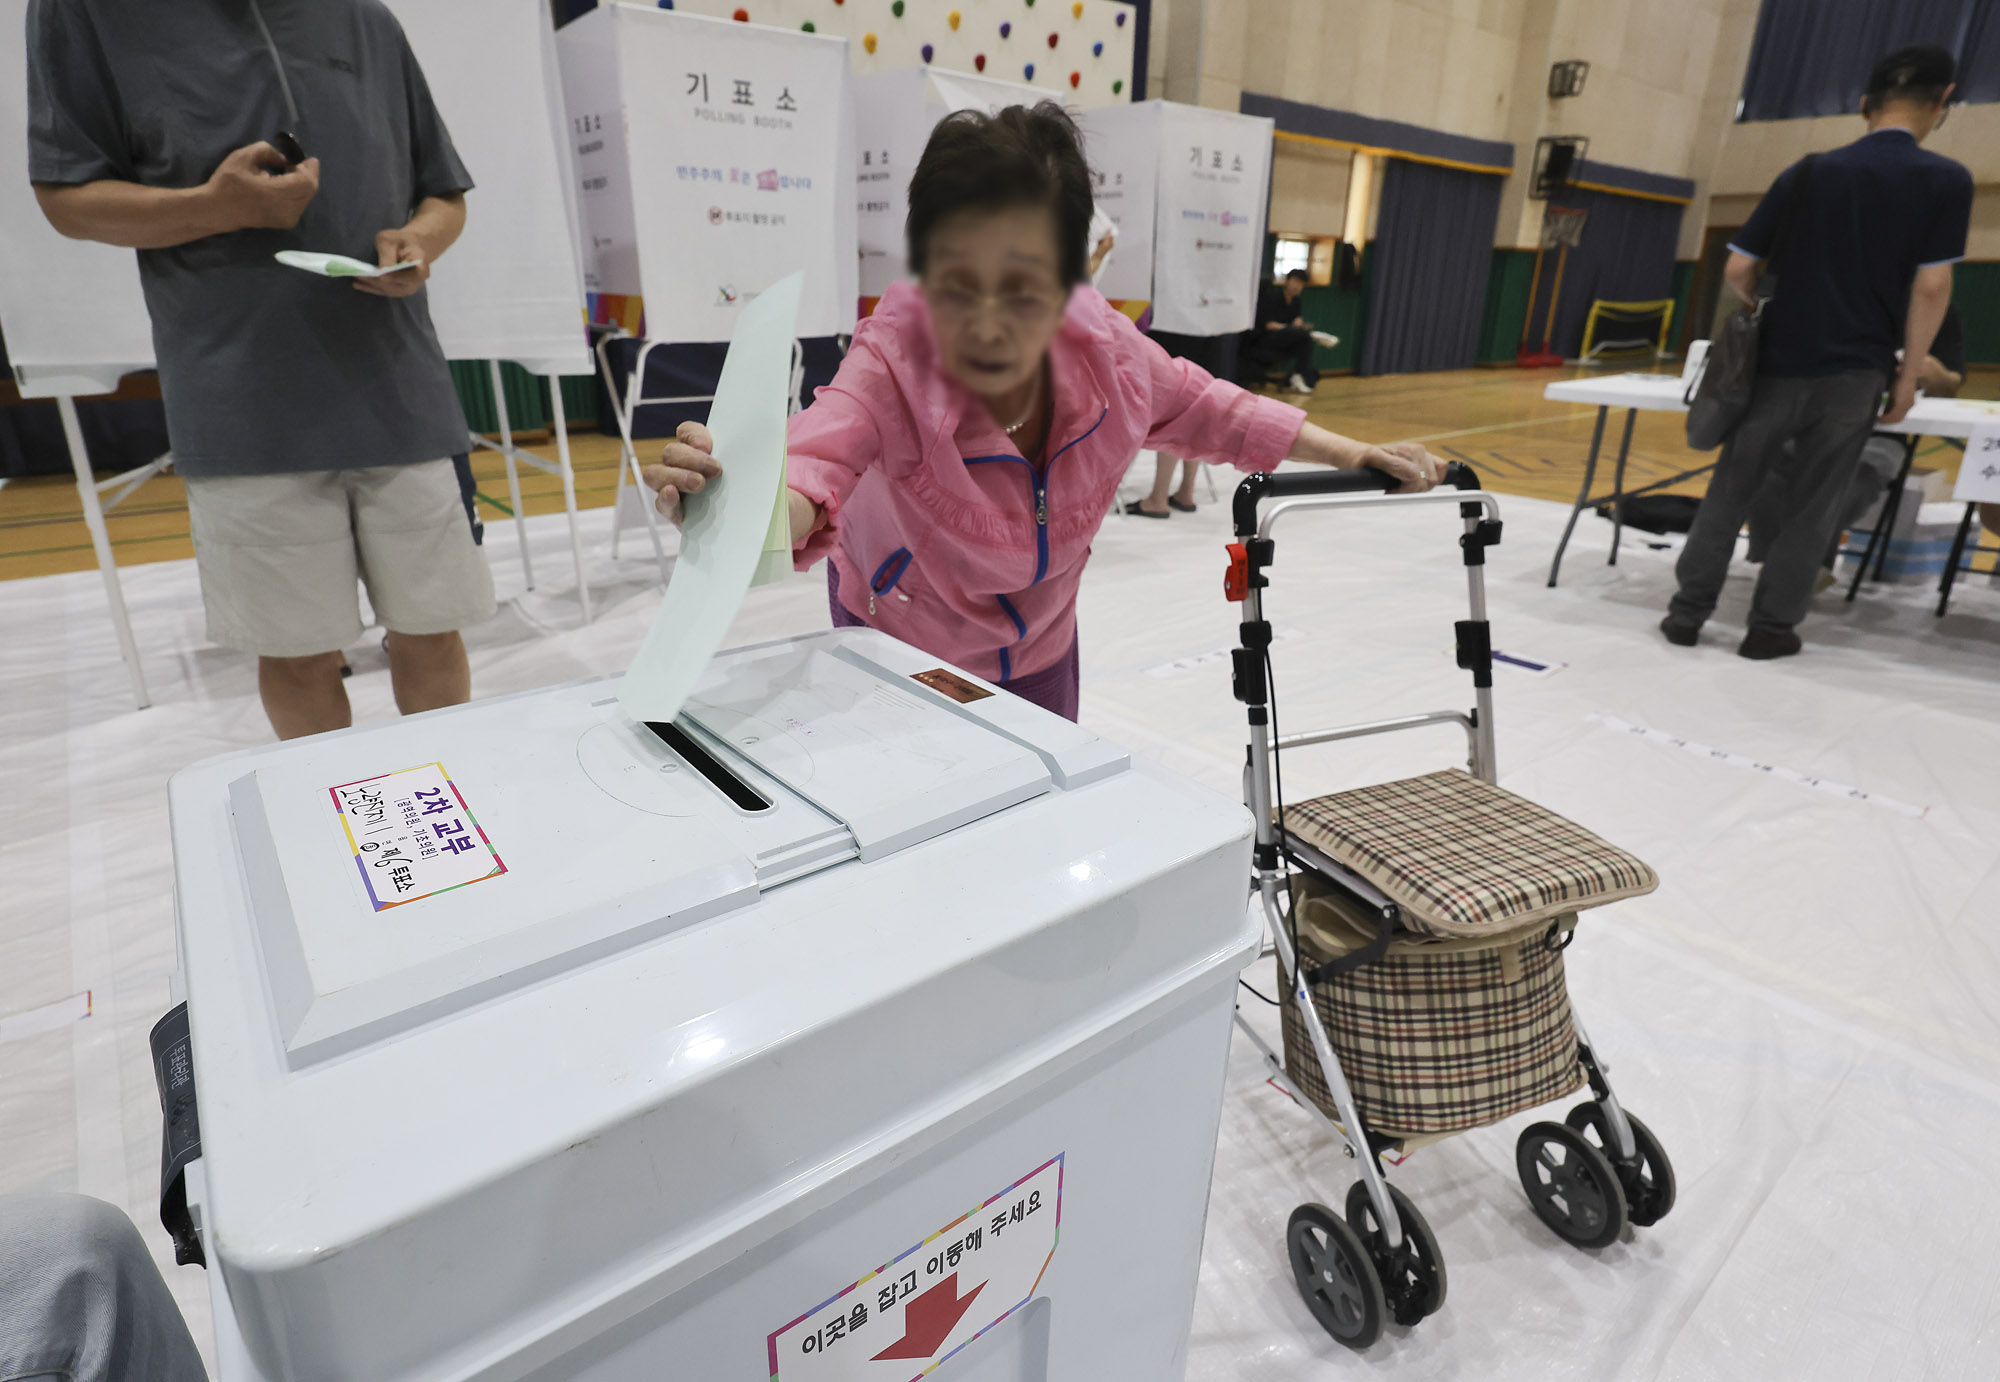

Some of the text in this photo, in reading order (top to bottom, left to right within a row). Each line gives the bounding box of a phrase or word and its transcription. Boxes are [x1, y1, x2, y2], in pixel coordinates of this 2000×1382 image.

[686, 72, 797, 112] 기 표 소
[694, 106, 793, 130] POLLING BOOTH
[414, 787, 475, 855] 2차 교부
[801, 1190, 1042, 1354] 이곳을 잡고 이동해 주세요
